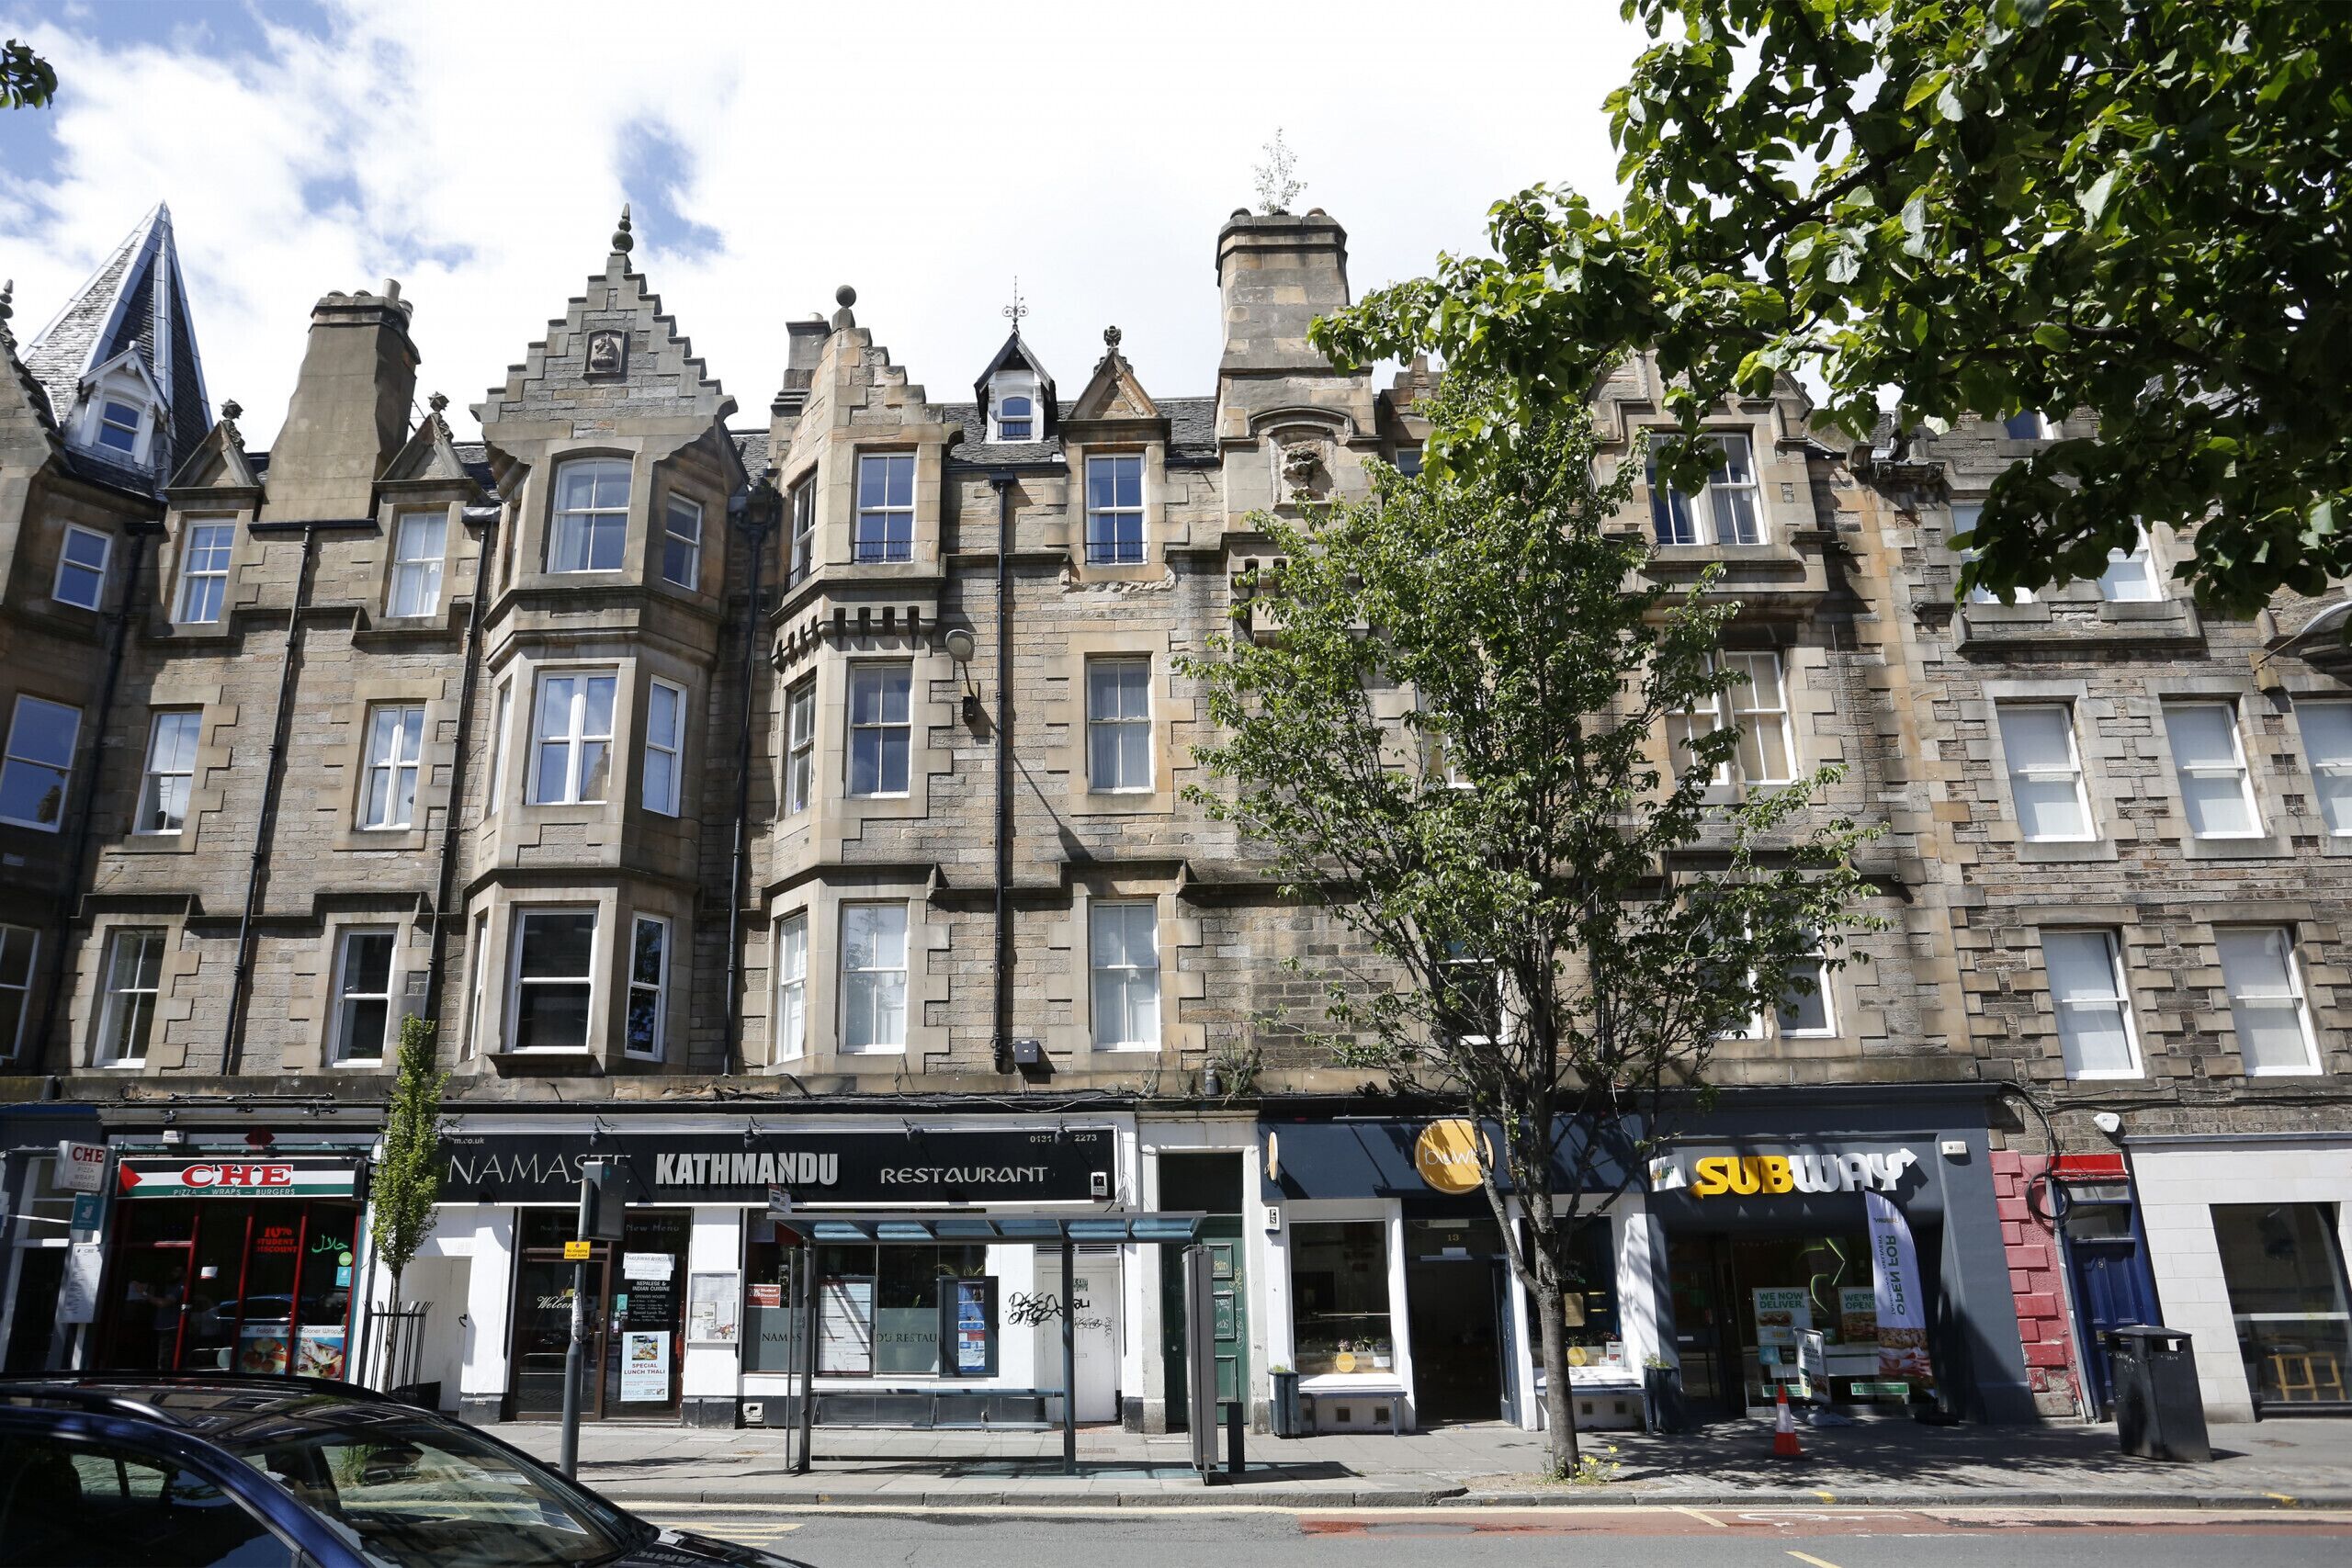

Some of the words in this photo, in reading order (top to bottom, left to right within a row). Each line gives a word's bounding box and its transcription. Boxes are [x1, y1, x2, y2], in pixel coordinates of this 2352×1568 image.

[73, 1146, 105, 1163] CHE
[181, 1164, 294, 1188] CHE
[655, 1152, 838, 1185] KATHMANDU
[880, 1167, 1048, 1184] RESTAURANT
[1690, 1147, 1917, 1200] SUBWAY
[264, 1226, 292, 1238] 10%
[311, 1234, 348, 1253] حلال
[1758, 1292, 1775, 1301] WE
[1778, 1292, 1804, 1301] NOW
[1759, 1301, 1805, 1309] DELIVER.
[1844, 1293, 1874, 1302] WE'RE
[896, 1333, 937, 1342] RESTAU
